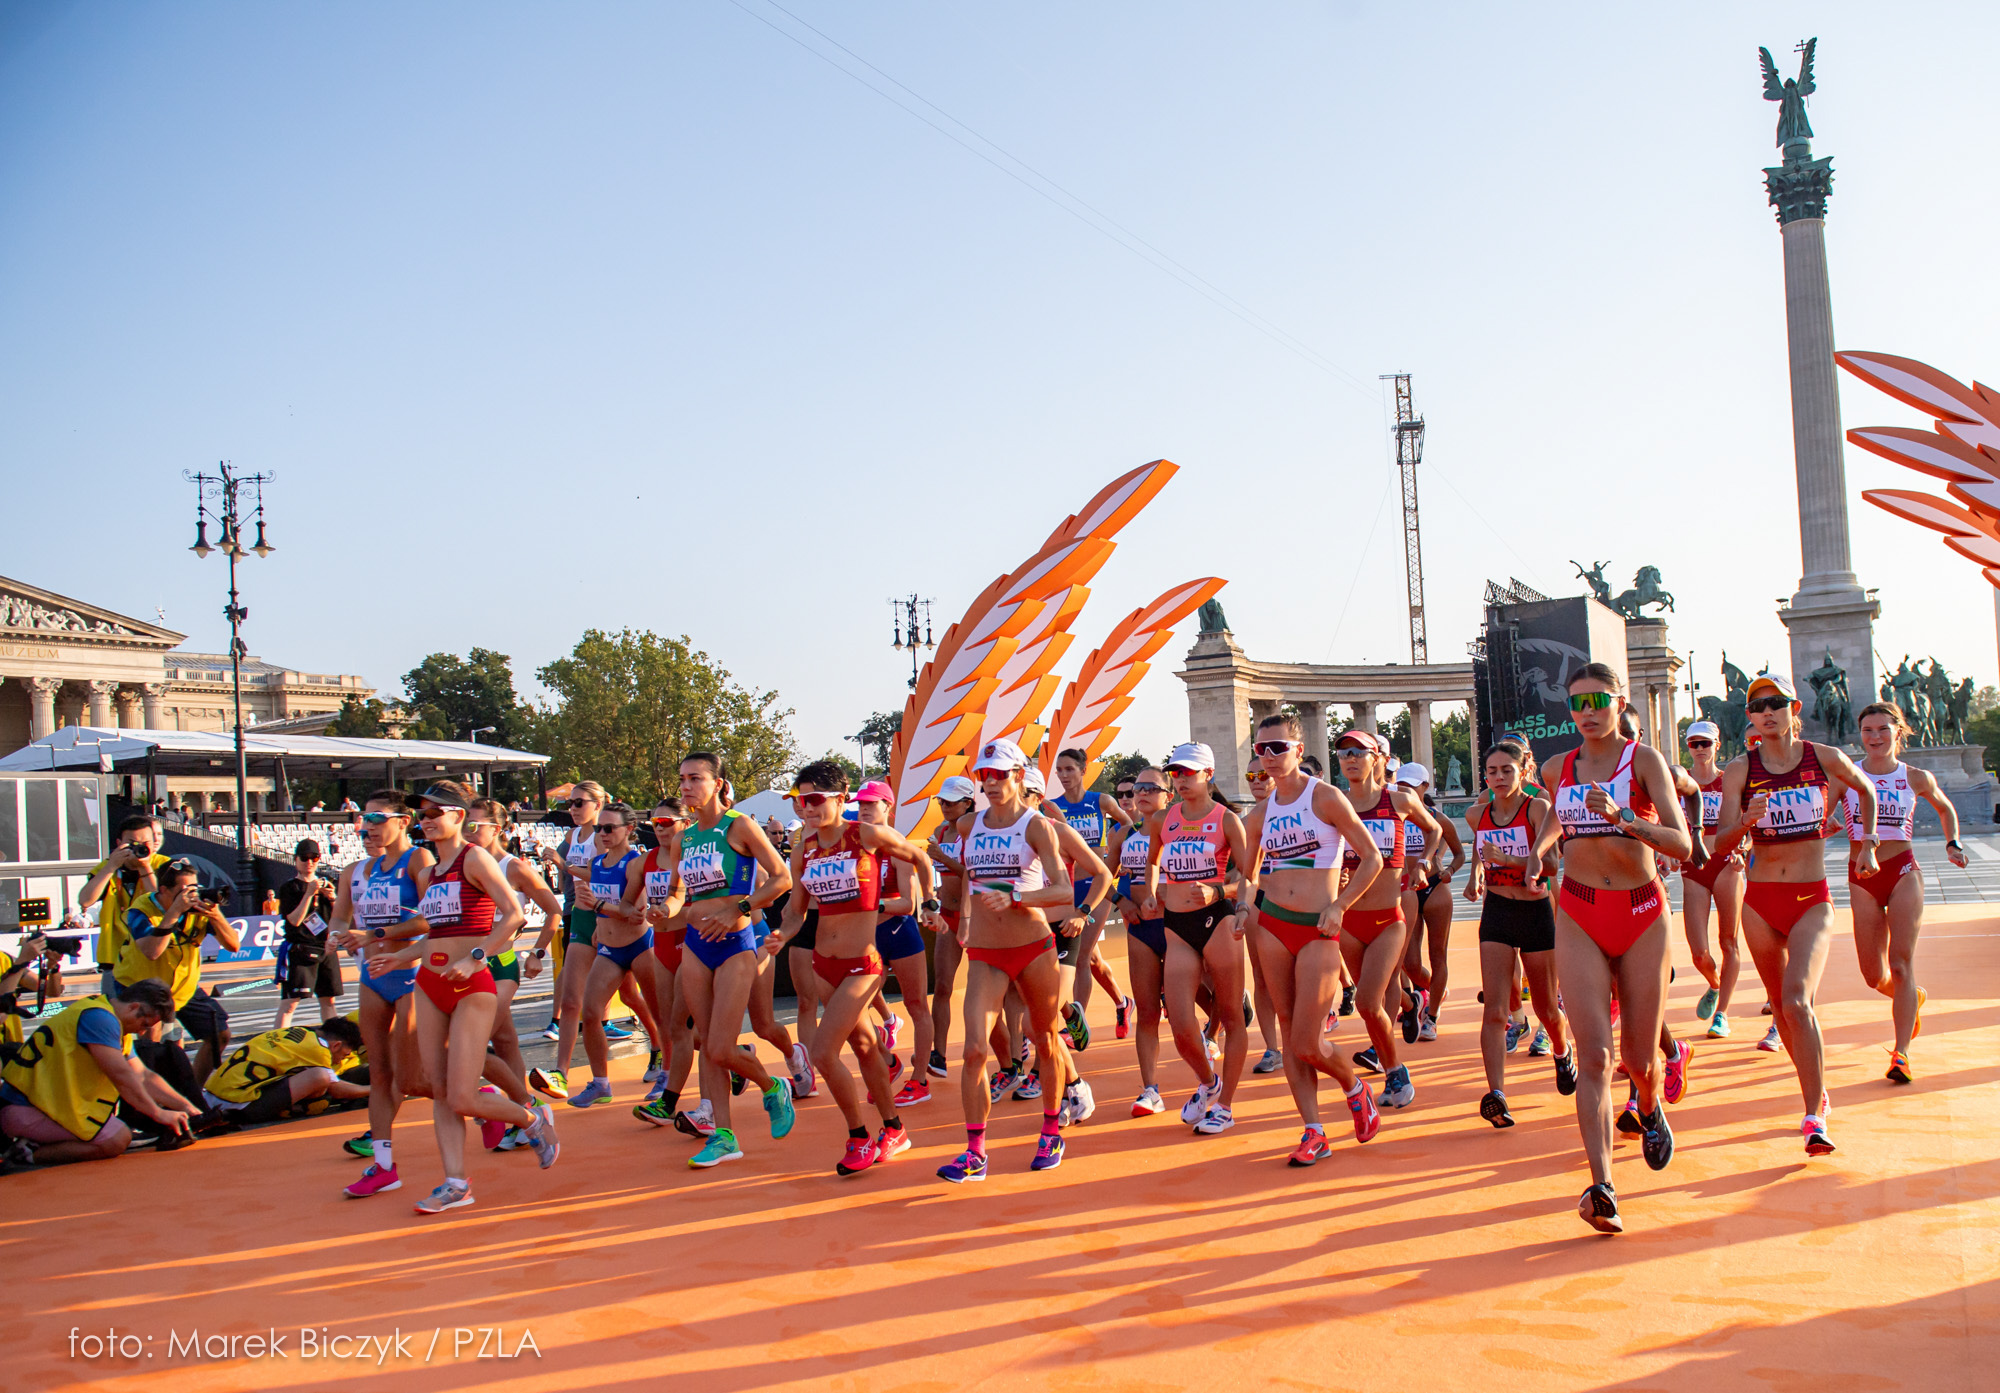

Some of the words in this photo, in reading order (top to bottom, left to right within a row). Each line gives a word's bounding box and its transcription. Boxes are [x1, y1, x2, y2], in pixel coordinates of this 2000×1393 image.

[1504, 713, 1546, 731] LASS
[1768, 788, 1811, 809] NTN
[1557, 805, 1586, 822] GARCÍA
[1770, 810, 1797, 825] MA
[1811, 806, 1823, 819] 112
[1269, 812, 1302, 834] NTN
[1777, 824, 1814, 835] BUDAPEST
[974, 835, 1012, 851] NTN
[1266, 832, 1297, 850] OLÁH
[1303, 829, 1316, 841] 139
[1383, 836, 1393, 847] 111
[1484, 828, 1516, 844] NTN
[683, 841, 721, 859] BRASIL
[1169, 842, 1205, 856] NTN
[1280, 846, 1309, 857] BUDAPEST
[1516, 845, 1528, 856] 177
[684, 854, 712, 872] NTN
[805, 850, 853, 868] ESPAÑA
[1007, 854, 1020, 865] 138
[1167, 858, 1197, 871] FUJII
[1203, 858, 1216, 868] 149
[809, 860, 845, 879] NTN
[1177, 872, 1208, 880] BUDAPEST
[364, 885, 389, 900] NTN
[426, 883, 450, 900] NTN
[591, 884, 612, 895] NTN
[650, 886, 667, 896] ING
[805, 879, 843, 894] PÉREZ
[845, 877, 857, 888] 127
[821, 893, 850, 902] BUDAPEST
[388, 903, 400, 914] 145
[420, 900, 442, 916] YANG
[447, 901, 459, 914] 114
[26, 1001, 63, 1015] WINESS
